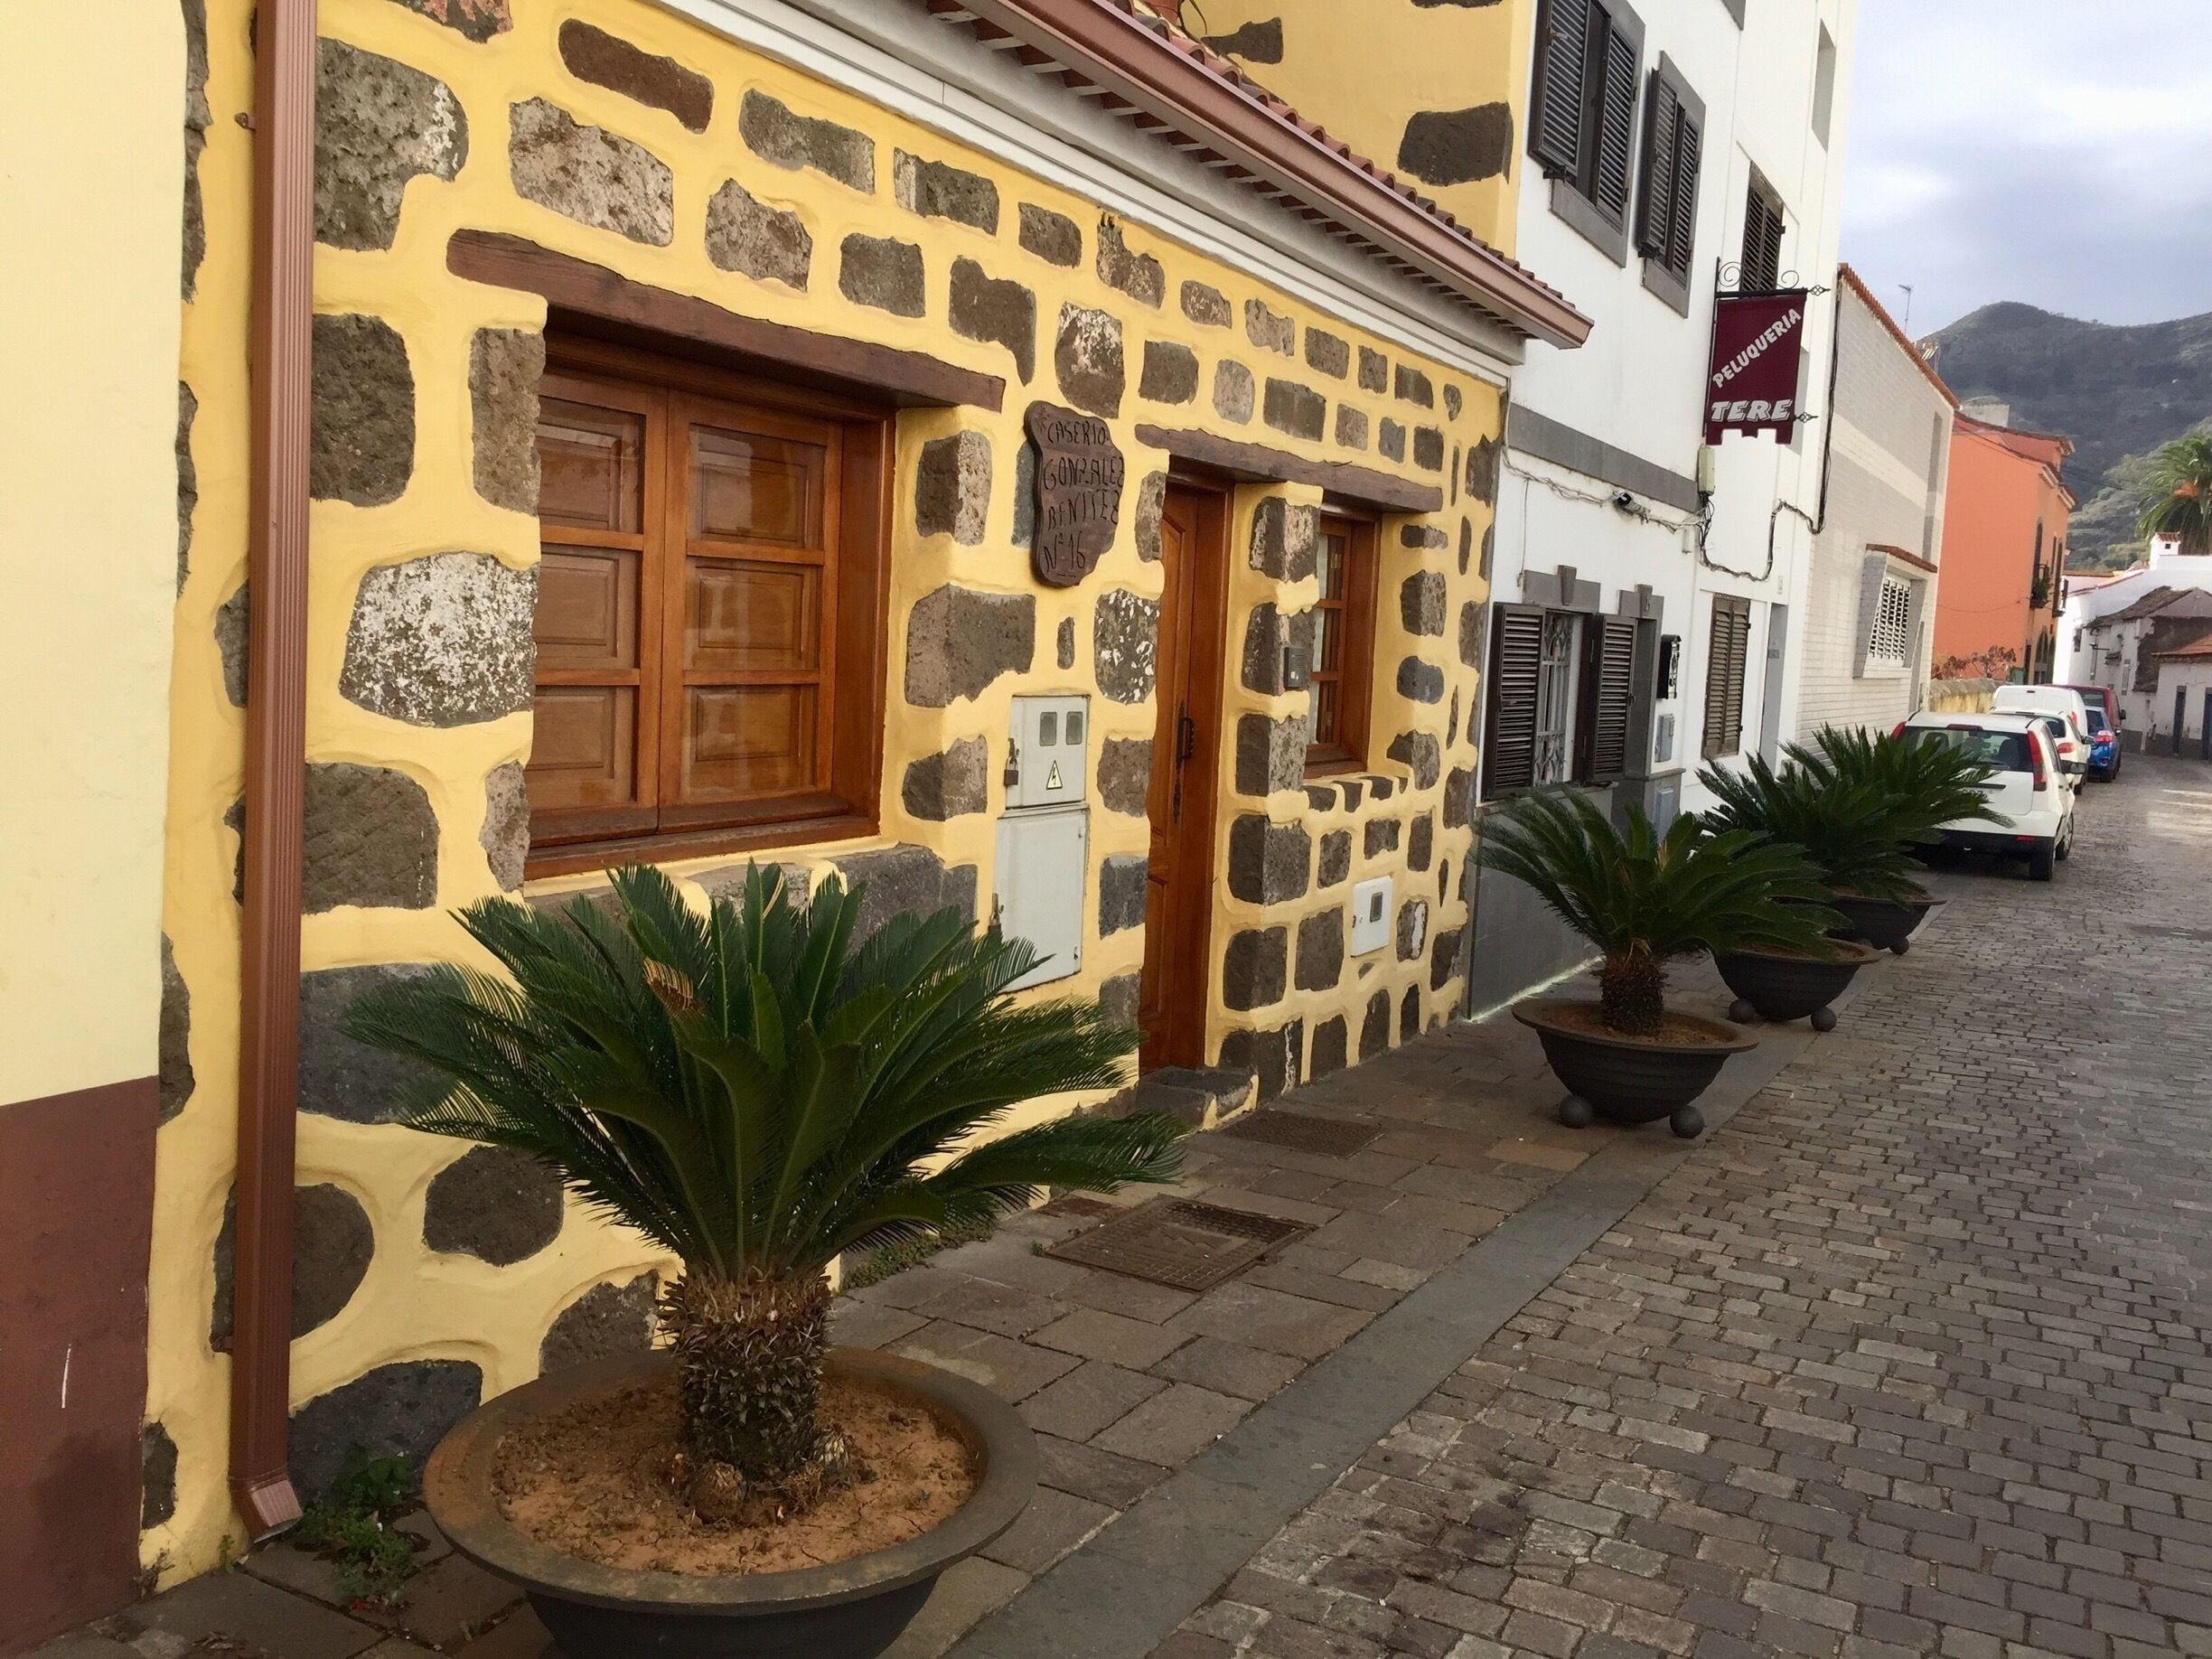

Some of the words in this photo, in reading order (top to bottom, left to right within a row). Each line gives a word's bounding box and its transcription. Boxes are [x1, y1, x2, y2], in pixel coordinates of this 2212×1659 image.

[1712, 308, 1802, 389] PELUQUERIA
[1711, 399, 1794, 422] TERE
[1044, 456, 1125, 491] GONZALEZ
[1048, 489, 1120, 530] BENITEZ
[1068, 531, 1086, 570] 16
